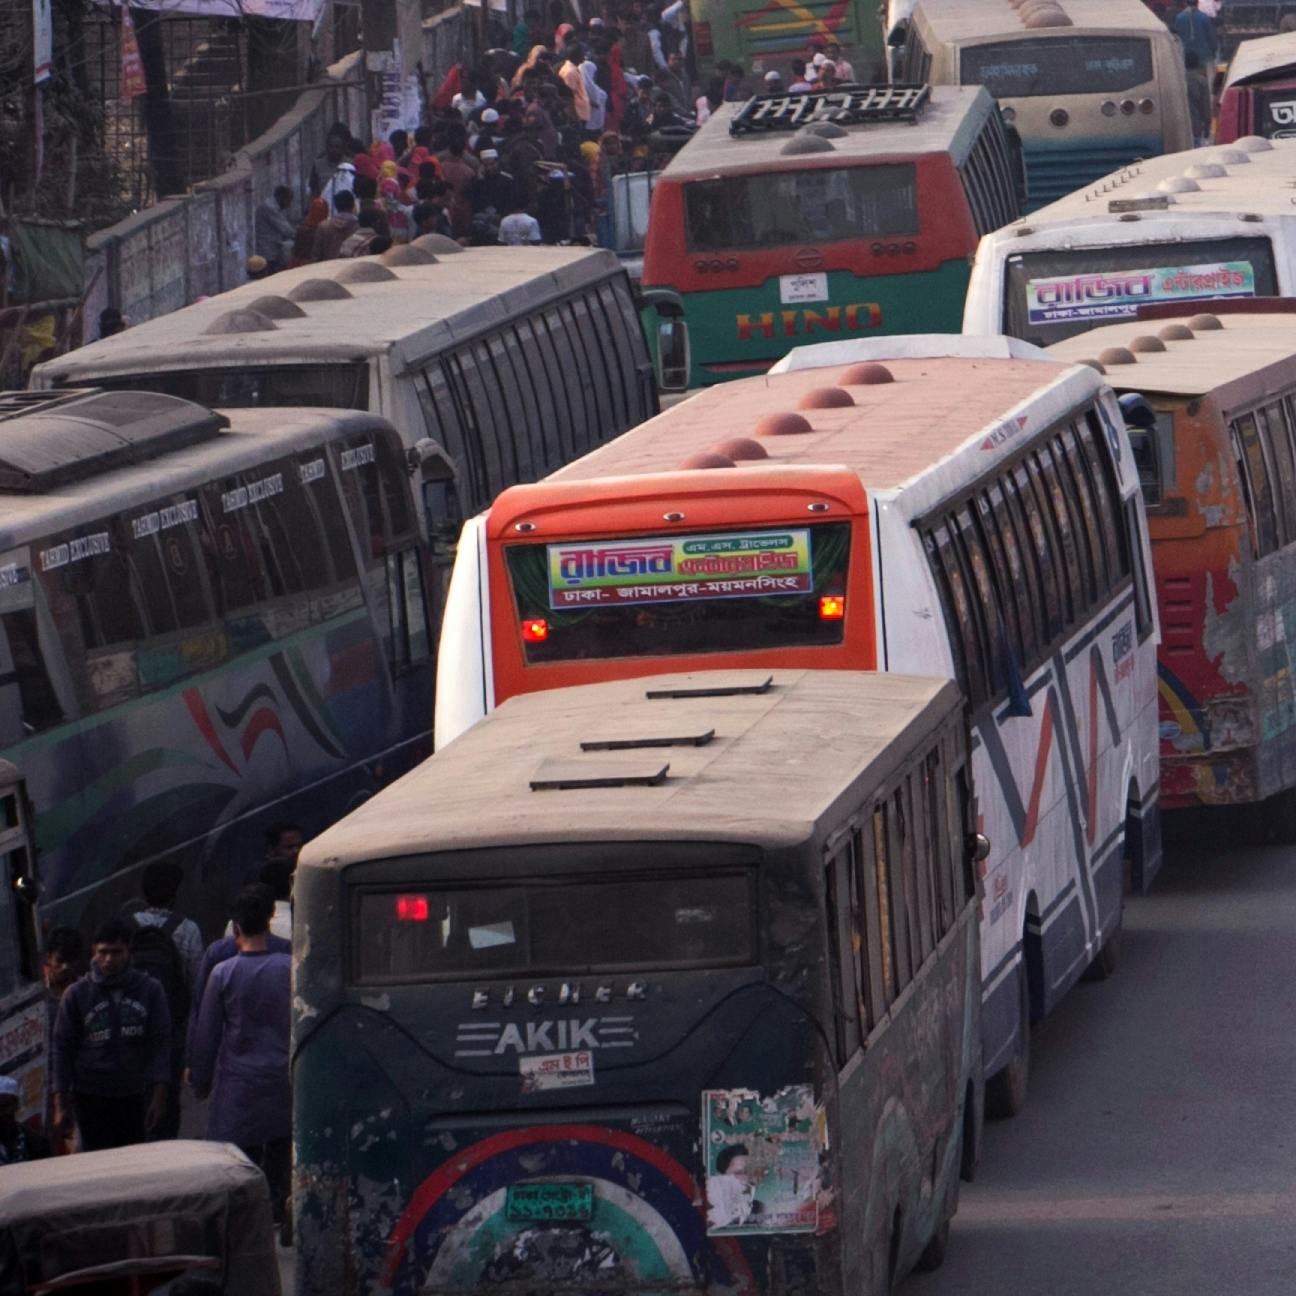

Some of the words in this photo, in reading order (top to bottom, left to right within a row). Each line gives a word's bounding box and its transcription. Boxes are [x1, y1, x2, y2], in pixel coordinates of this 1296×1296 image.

[736, 303, 882, 341] HINO
[560, 544, 673, 585] রাজিব
[471, 981, 647, 1009] EICHER
[494, 1017, 601, 1054] AKIK
